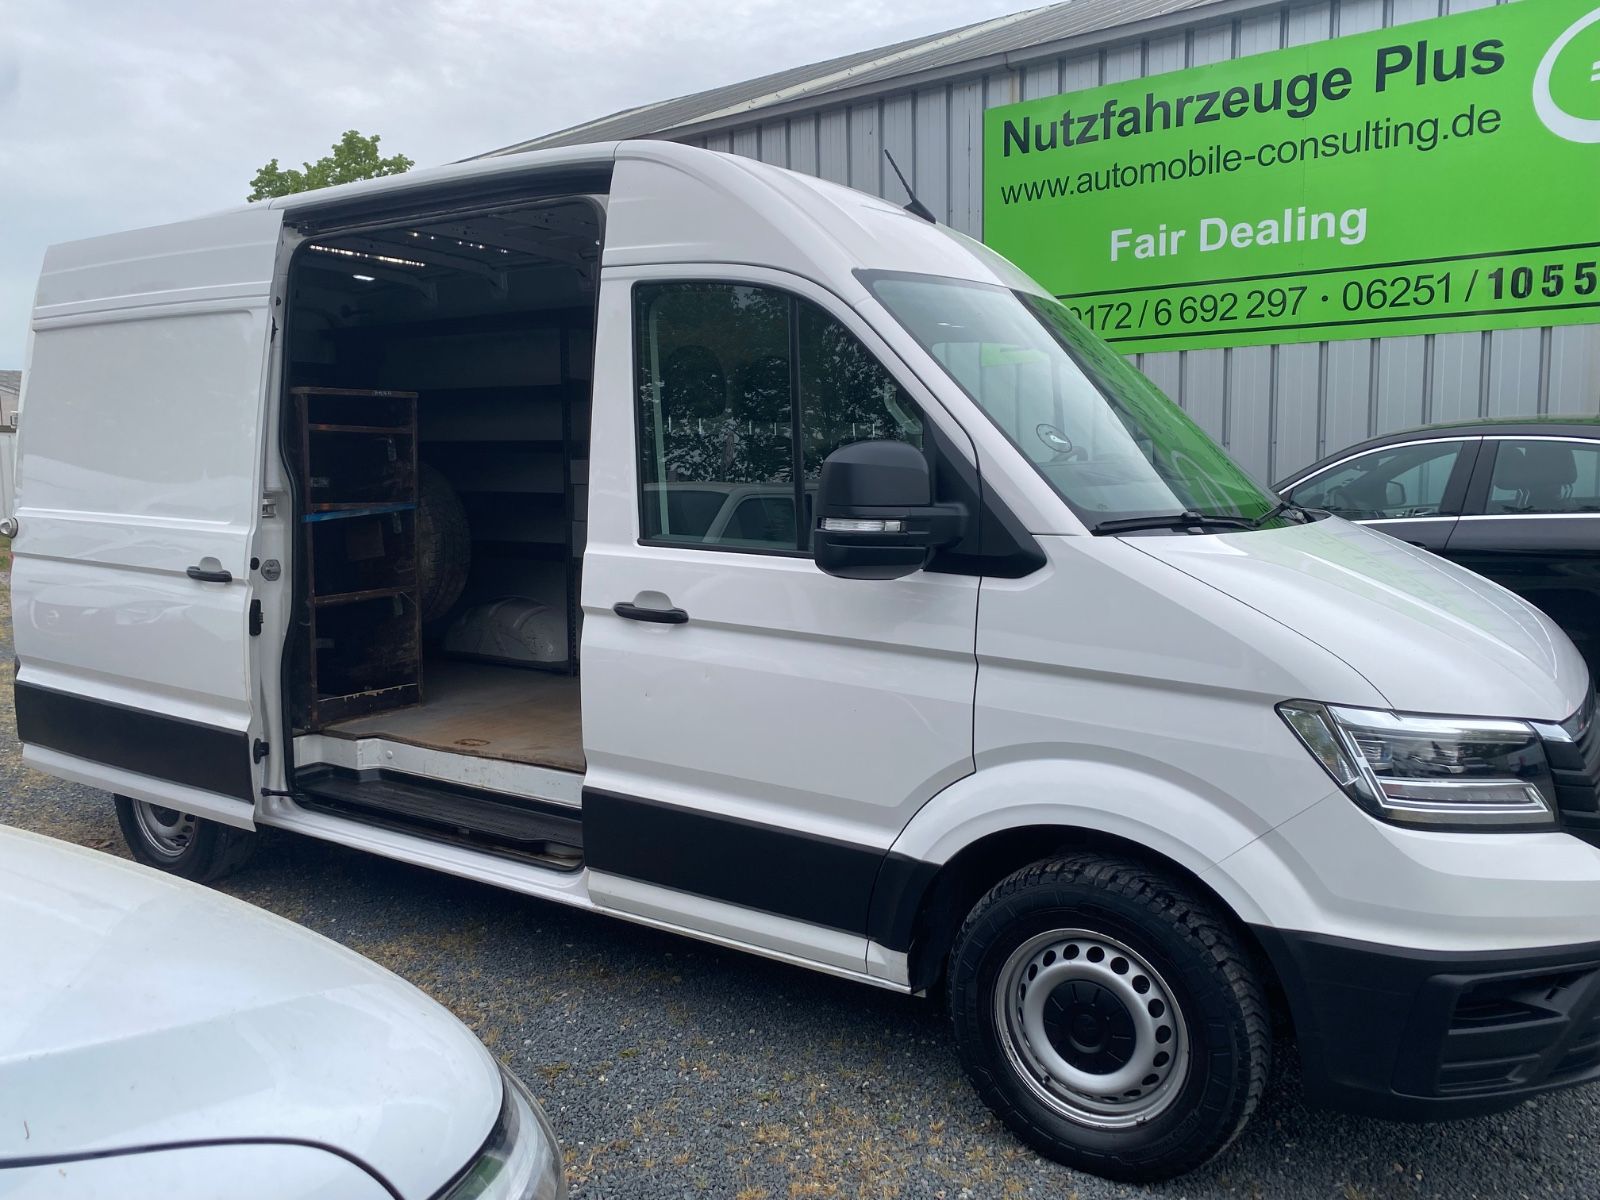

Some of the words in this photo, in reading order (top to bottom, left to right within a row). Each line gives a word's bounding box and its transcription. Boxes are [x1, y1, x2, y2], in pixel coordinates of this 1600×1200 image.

[1003, 66, 1353, 158] Nutzfahrzeuge
[1375, 39, 1505, 93] Plus
[1001, 104, 1502, 205] www.automobile-consulting.de
[1110, 225, 1186, 262] Fair
[1200, 206, 1368, 251] Dealing
